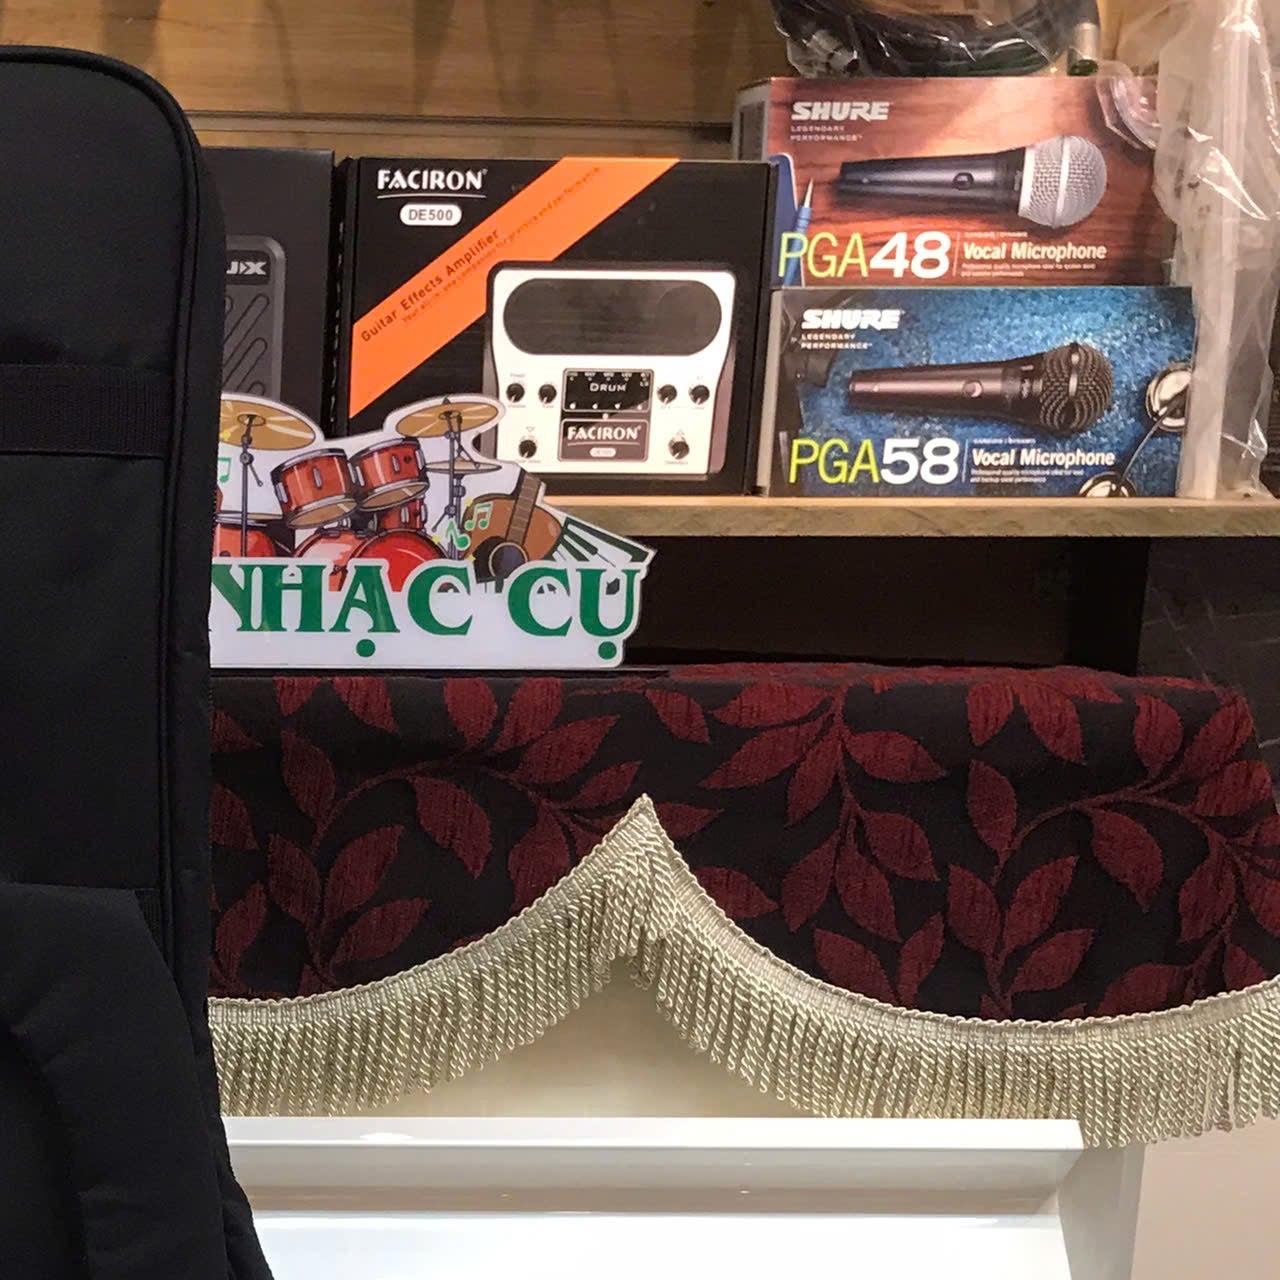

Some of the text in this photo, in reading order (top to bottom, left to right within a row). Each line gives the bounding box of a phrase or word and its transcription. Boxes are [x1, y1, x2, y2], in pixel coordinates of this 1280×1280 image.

[791, 101, 890, 122] SHURE
[378, 169, 482, 191] FACIRON
[408, 208, 453, 222] DE500
[778, 231, 952, 279] PGA48
[963, 241, 1107, 263] Vocal Microphone
[361, 309, 398, 342] Guitar
[400, 275, 443, 311] Effects
[446, 230, 500, 276] Amplifier
[801, 309, 900, 331] SHURE
[567, 426, 638, 440] FACIRON
[789, 438, 960, 485] PGA58
[972, 448, 1116, 469] Vocal Microphone
[211, 563, 641, 661] NHẠC CỤ
